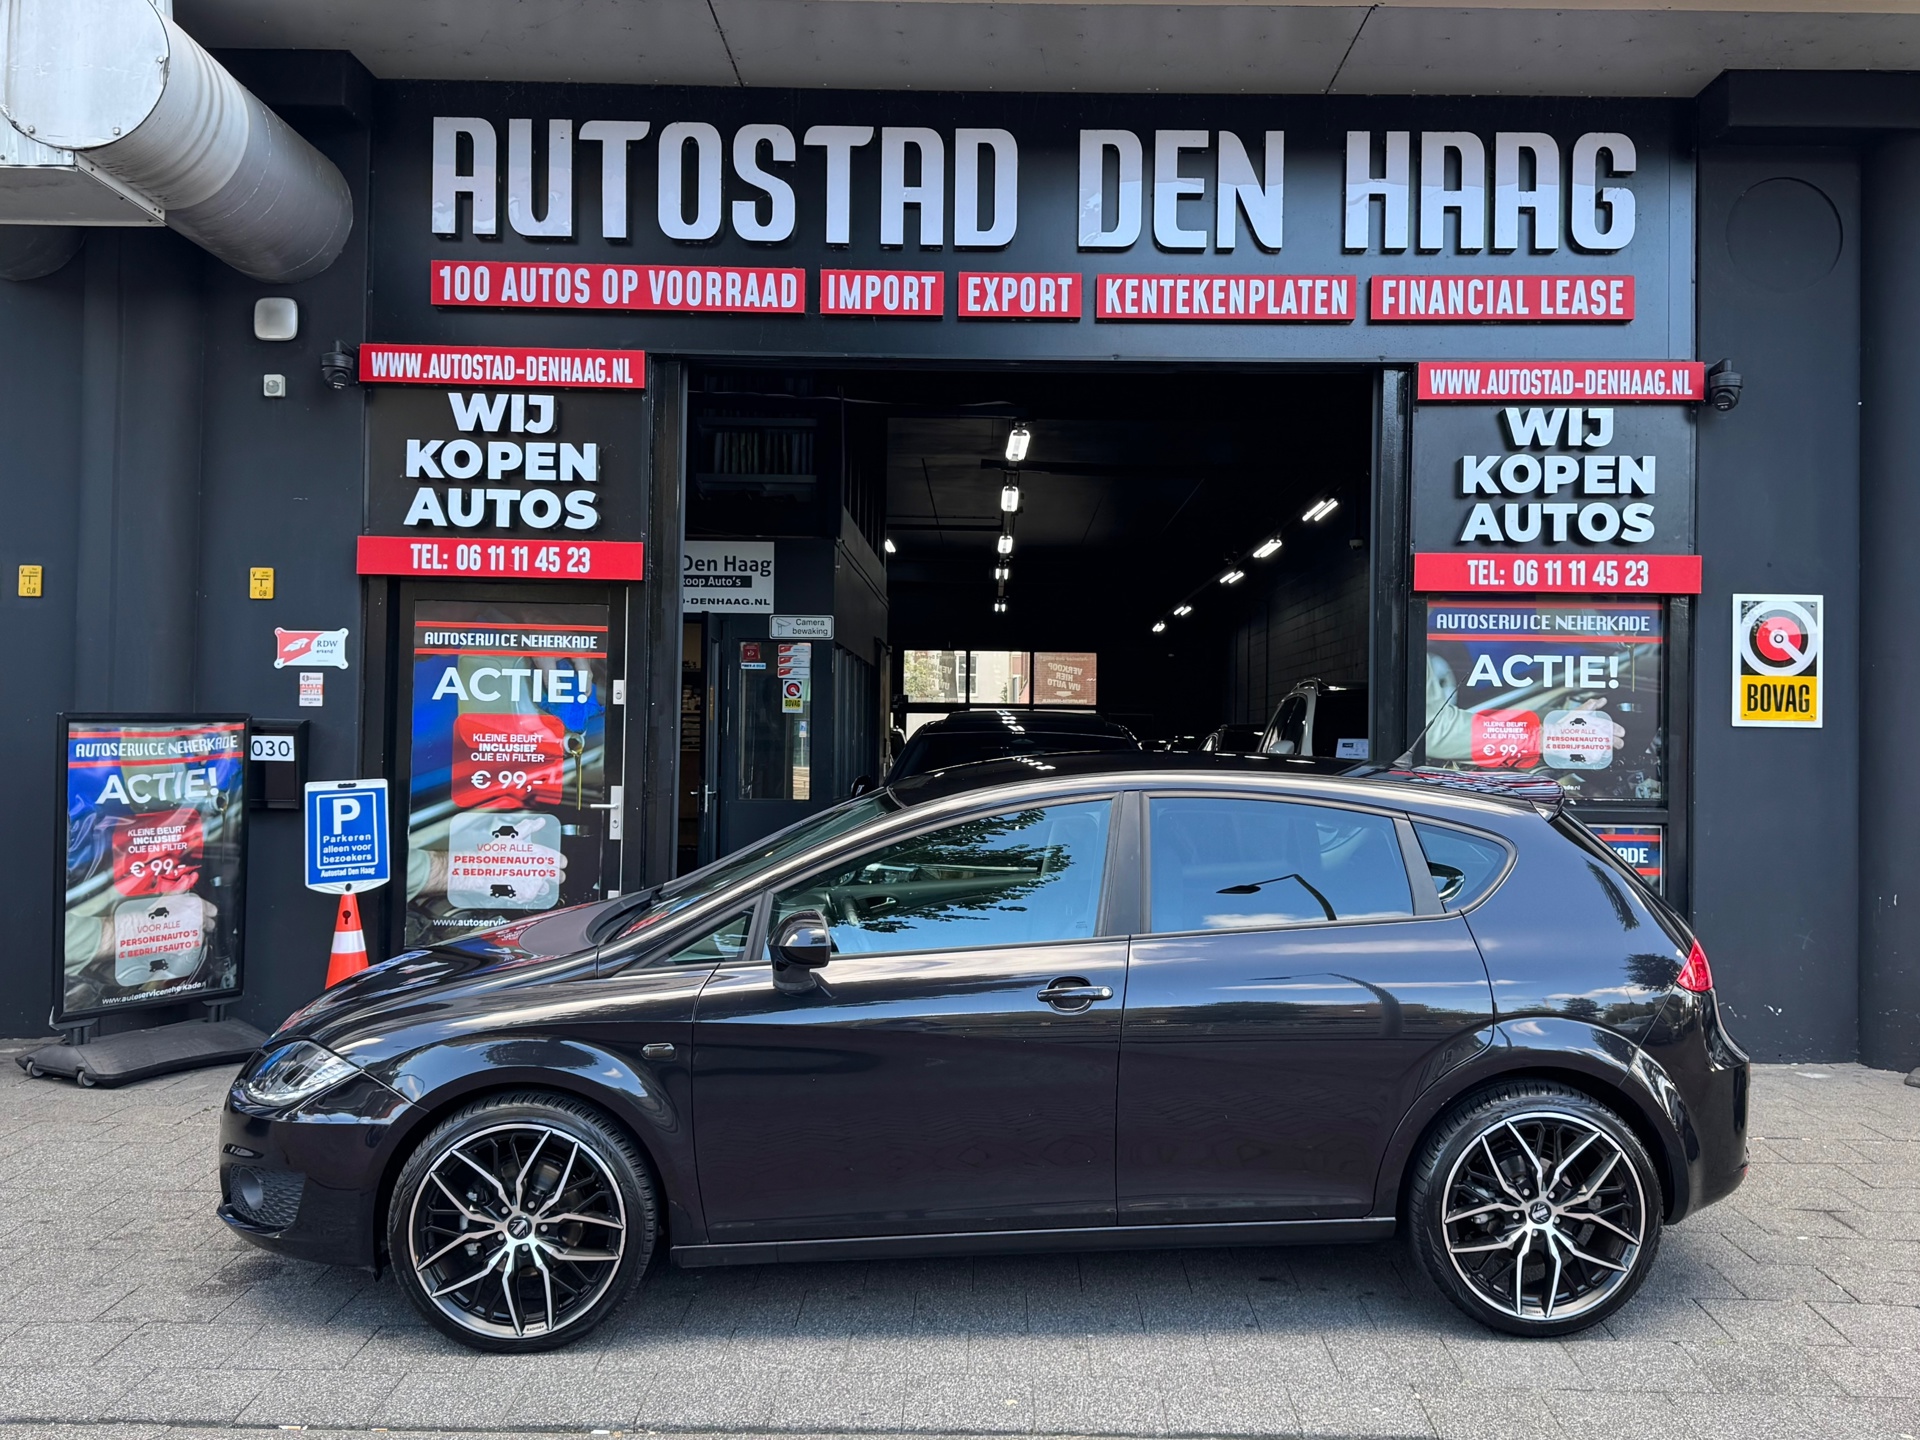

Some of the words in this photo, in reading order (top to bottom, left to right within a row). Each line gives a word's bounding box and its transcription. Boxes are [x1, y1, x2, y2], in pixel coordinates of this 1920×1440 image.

[432, 117, 1018, 246] AUTOSTAD
[1078, 129, 1284, 249] DEN
[1344, 131, 1637, 249] HAAG
[438, 265, 490, 301] 100
[501, 266, 591, 303] AUTOS
[602, 268, 639, 305] OP
[648, 269, 797, 308] VOORRAAD
[828, 274, 936, 311] IMPORT
[967, 276, 1073, 313] EXPORT
[1105, 278, 1348, 316] KENTEKENPLATEN
[1381, 279, 1529, 315] FINANCIAL
[1541, 279, 1625, 316] LEASE
[371, 351, 634, 384] WWW.AUTOSTAD-DENHAAG.NL
[1430, 368, 1693, 396] WWW.AUTOSTAD-DENHAAG.NL
[447, 392, 555, 434] WIJ
[1504, 407, 1614, 447] WIJ
[405, 438, 598, 482] KOPEN
[1462, 453, 1656, 495] KOPEN
[403, 487, 599, 530] AUTOS
[1460, 502, 1655, 543] AUTOS
[410, 543, 449, 570] TEL:
[456, 544, 482, 570] 06
[487, 544, 505, 571] 11
[511, 545, 529, 572] 11
[534, 546, 561, 573] 45
[566, 547, 591, 573] 23
[724, 555, 772, 577] Haag
[708, 576, 742, 587] Auto's
[1467, 559, 1505, 586] TEL:
[1513, 560, 1538, 586] 06
[1544, 560, 1562, 586] 11
[1568, 560, 1586, 586] 11
[1592, 560, 1618, 587] 45
[1624, 560, 1649, 587] 23
[683, 598, 771, 606] -DENHAAG.NL
[795, 618, 825, 626] Camera
[1436, 613, 1551, 631] AUTOSERVICE
[1555, 615, 1651, 632] NEHERKADE
[424, 631, 519, 647] AUTOSERVICE
[521, 634, 598, 649] NEHERKADE
[792, 627, 829, 637] bewaking
[316, 640, 338, 648] RDW
[1466, 653, 1620, 690] ACTIE!
[431, 666, 589, 704] ACTIE!
[1747, 683, 1810, 713] BOVAG
[75, 742, 166, 758] AUTOSERVICE
[167, 735, 238, 755] NEHERKADE
[472, 733, 508, 743] KLEINE
[509, 733, 544, 743] BEURT
[251, 740, 290, 757] 030
[470, 752, 494, 762] OLIE
[496, 753, 510, 762] EN
[512, 753, 545, 763] FILTER
[478, 743, 538, 753] INCLUSIEF
[1483, 744, 1496, 756] €
[95, 767, 220, 805] ACTIE!
[470, 770, 492, 790] €
[332, 798, 361, 835] P
[127, 827, 156, 837] KLEINE
[156, 825, 187, 836] BEURT
[133, 834, 182, 845] INCLUSIEF
[322, 834, 372, 844] Parkeren
[127, 844, 148, 854] OLIE
[148, 844, 160, 853] EN
[161, 842, 188, 852] FILTER
[322, 844, 350, 854] alleen
[351, 843, 372, 852] voor
[476, 843, 507, 852] VOOR
[508, 843, 534, 852] ALLE
[1613, 846, 1649, 864] ADE
[322, 853, 372, 864] bezoekers
[453, 855, 555, 865] PERSONENAUTO'S
[130, 861, 146, 878] €
[320, 868, 347, 878] Autostad
[347, 867, 360, 876] Den
[360, 866, 376, 876] Haag
[462, 868, 556, 878] BEDRIJFSAUTO'S
[137, 922, 162, 934] VOOR
[163, 920, 181, 932] ALLE
[120, 929, 199, 948] PERSONENAUTO'S
[127, 940, 200, 959] BEDRIJFSAUTO'S
